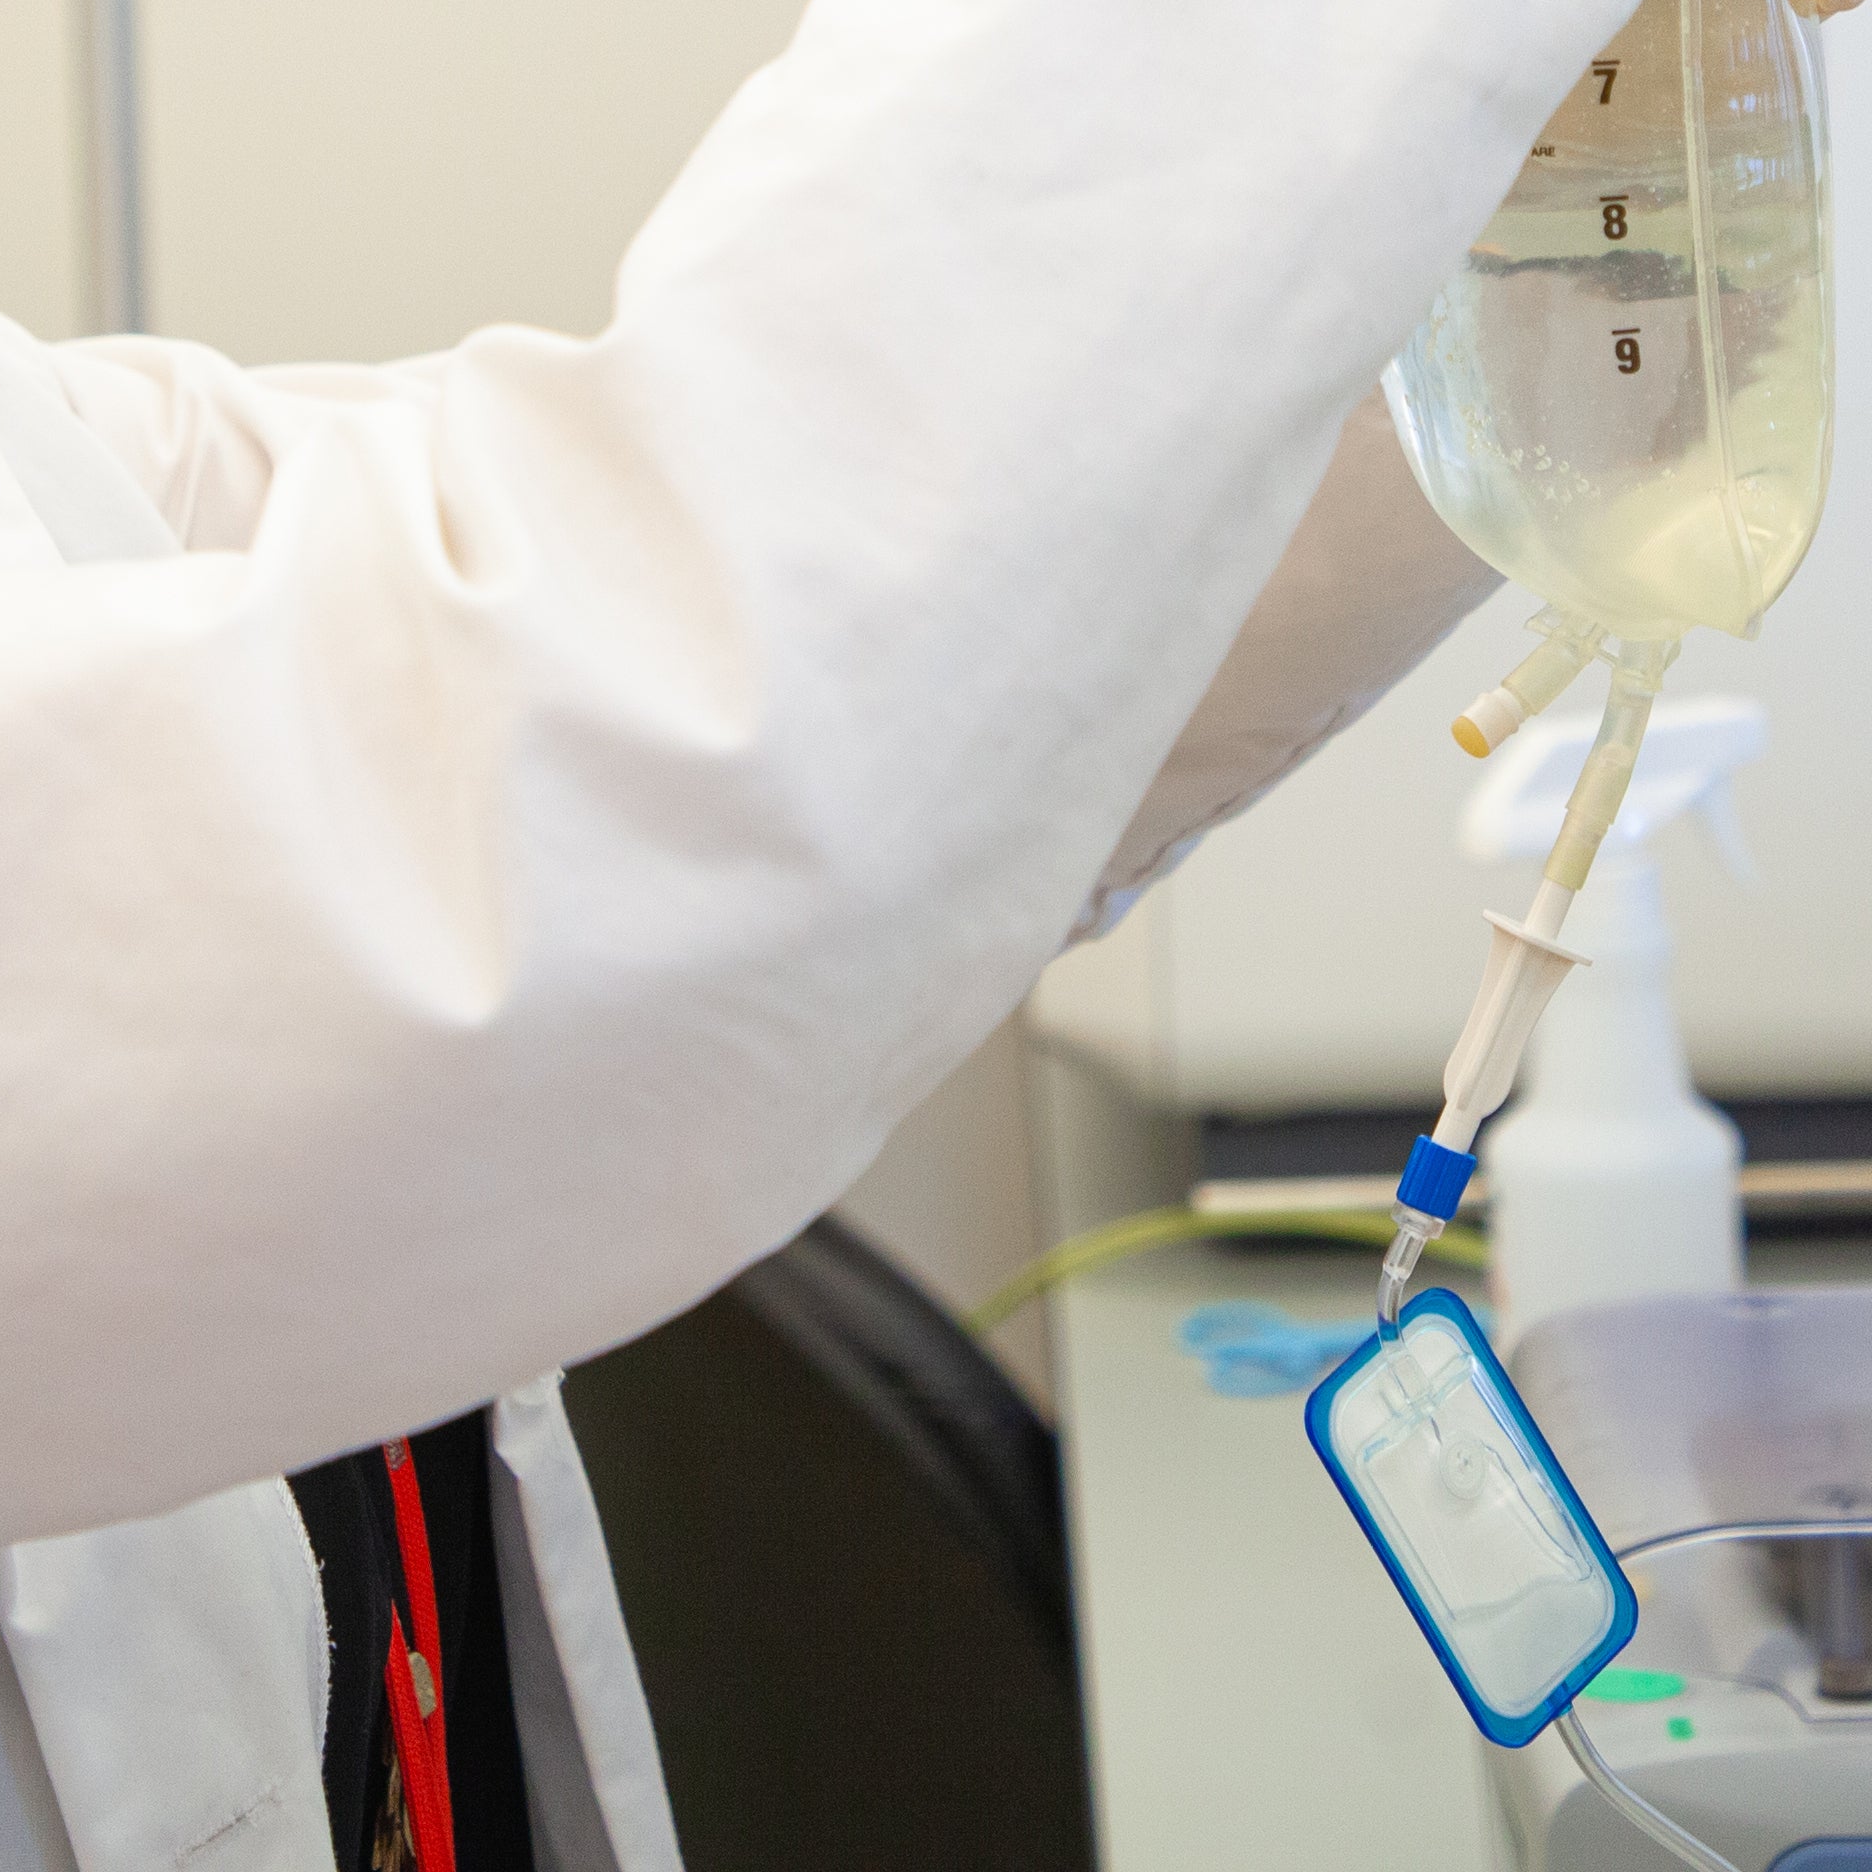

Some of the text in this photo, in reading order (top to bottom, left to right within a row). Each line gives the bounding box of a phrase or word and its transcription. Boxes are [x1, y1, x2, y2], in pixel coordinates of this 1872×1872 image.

[1593, 68, 1618, 105] 7
[1602, 203, 1628, 241] 8
[1615, 337, 1641, 375] 9
